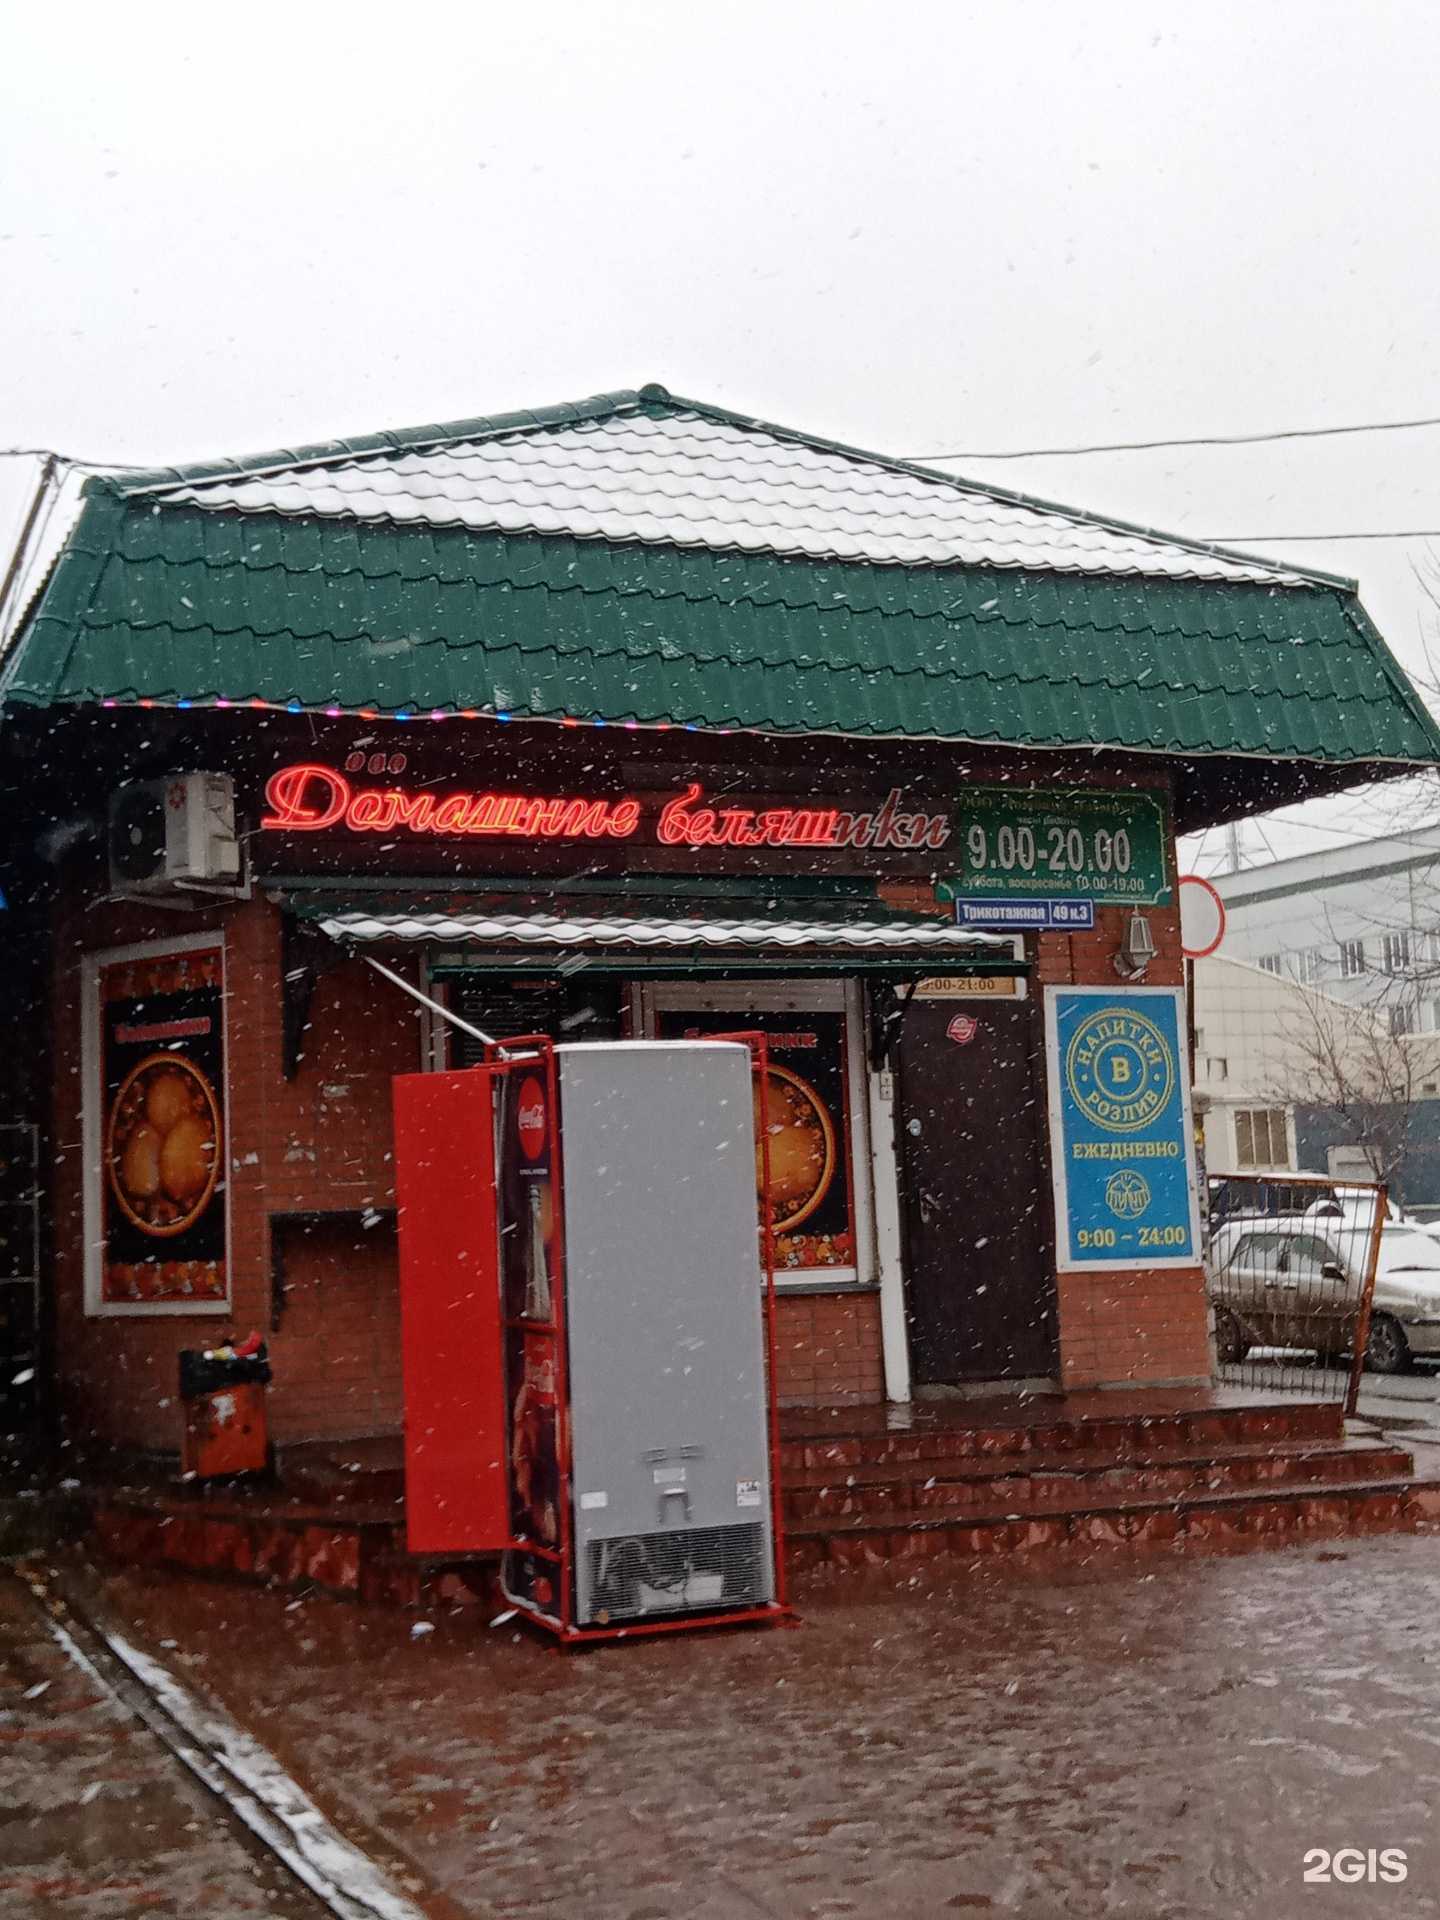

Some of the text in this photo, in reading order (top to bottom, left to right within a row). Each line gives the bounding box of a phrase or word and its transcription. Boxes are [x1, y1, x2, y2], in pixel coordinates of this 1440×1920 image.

[260, 763, 951, 849] Домашние беляшики
[963, 904, 1045, 921] Трикотажная
[1053, 905, 1069, 920] 49
[1077, 1018, 1162, 1066] НАПИТКИ
[1111, 1056, 1131, 1083] В
[1084, 1088, 1160, 1123] РОЗЛИВ
[1071, 1140, 1180, 1161] ЕЖЕДНЕВНО
[1077, 1227, 1116, 1249] 9:00
[1138, 1225, 1186, 1247] 24:00
